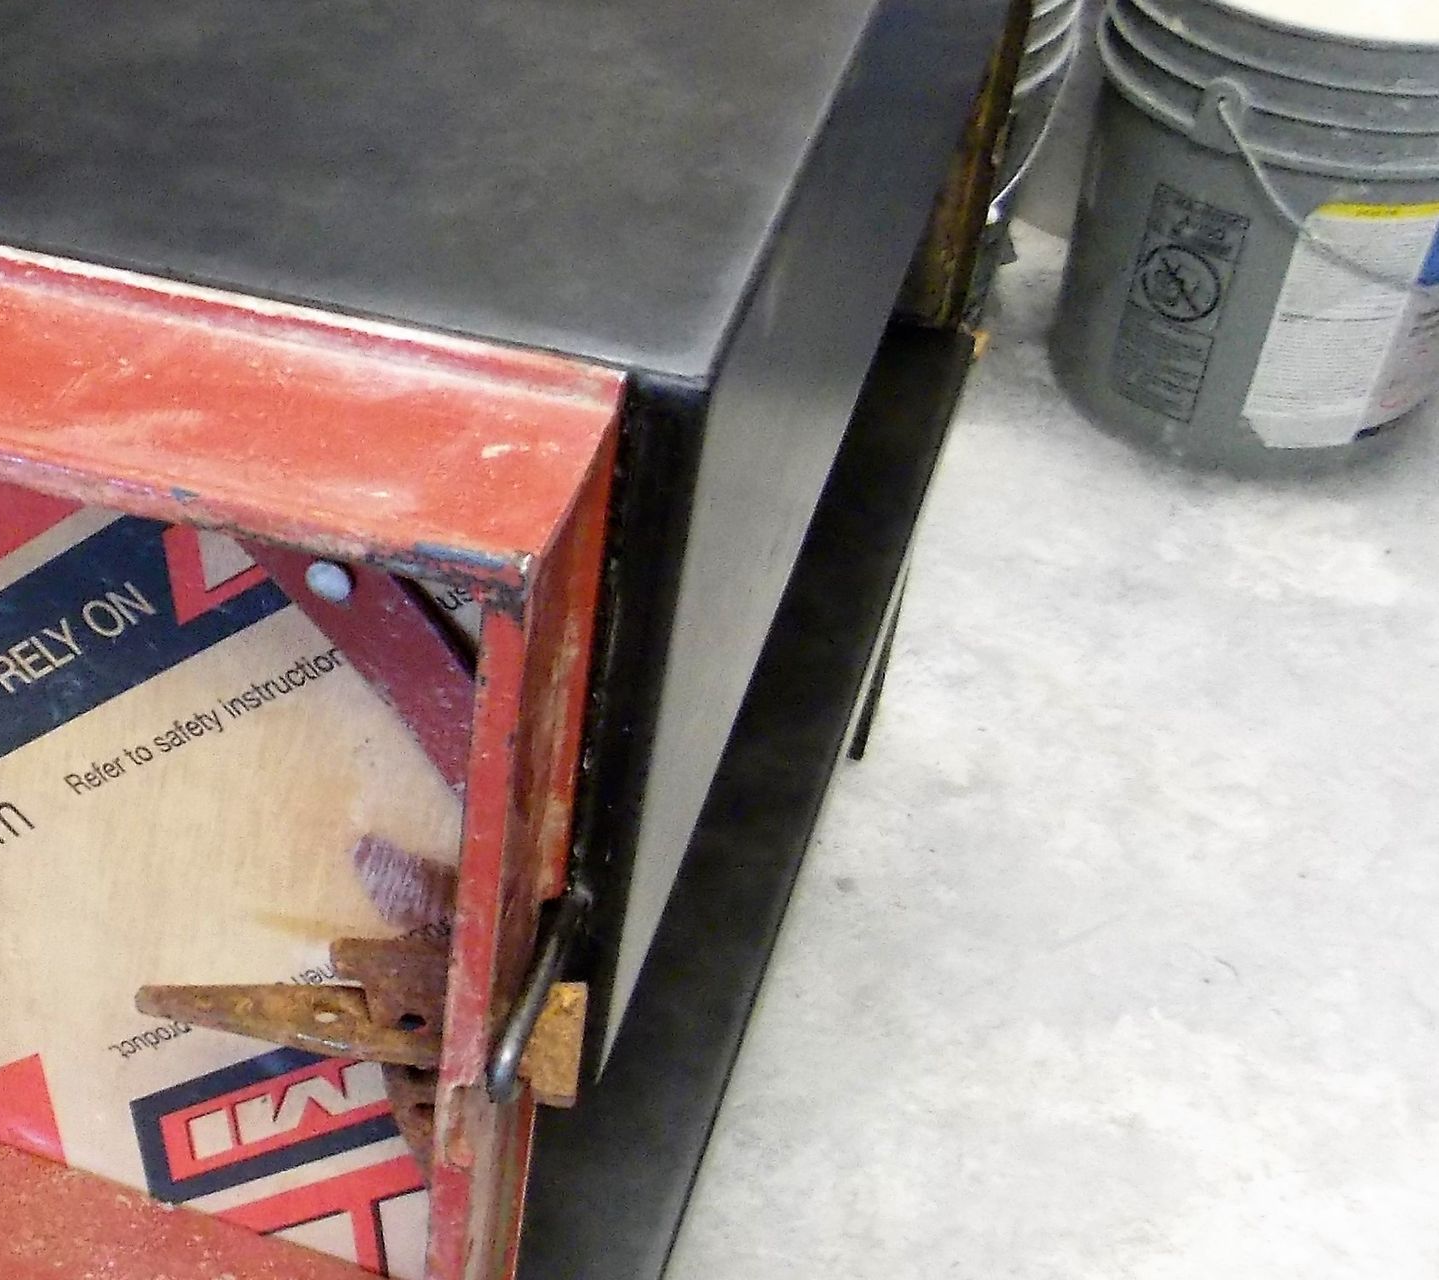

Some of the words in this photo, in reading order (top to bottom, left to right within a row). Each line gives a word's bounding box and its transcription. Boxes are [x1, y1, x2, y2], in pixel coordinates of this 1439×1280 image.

[82, 579, 157, 637] ON
[64, 755, 127, 796] Refer
[128, 739, 154, 766] to
[153, 706, 226, 754] safety
[222, 646, 344, 718] instruction
[185, 1058, 389, 1162] MI
